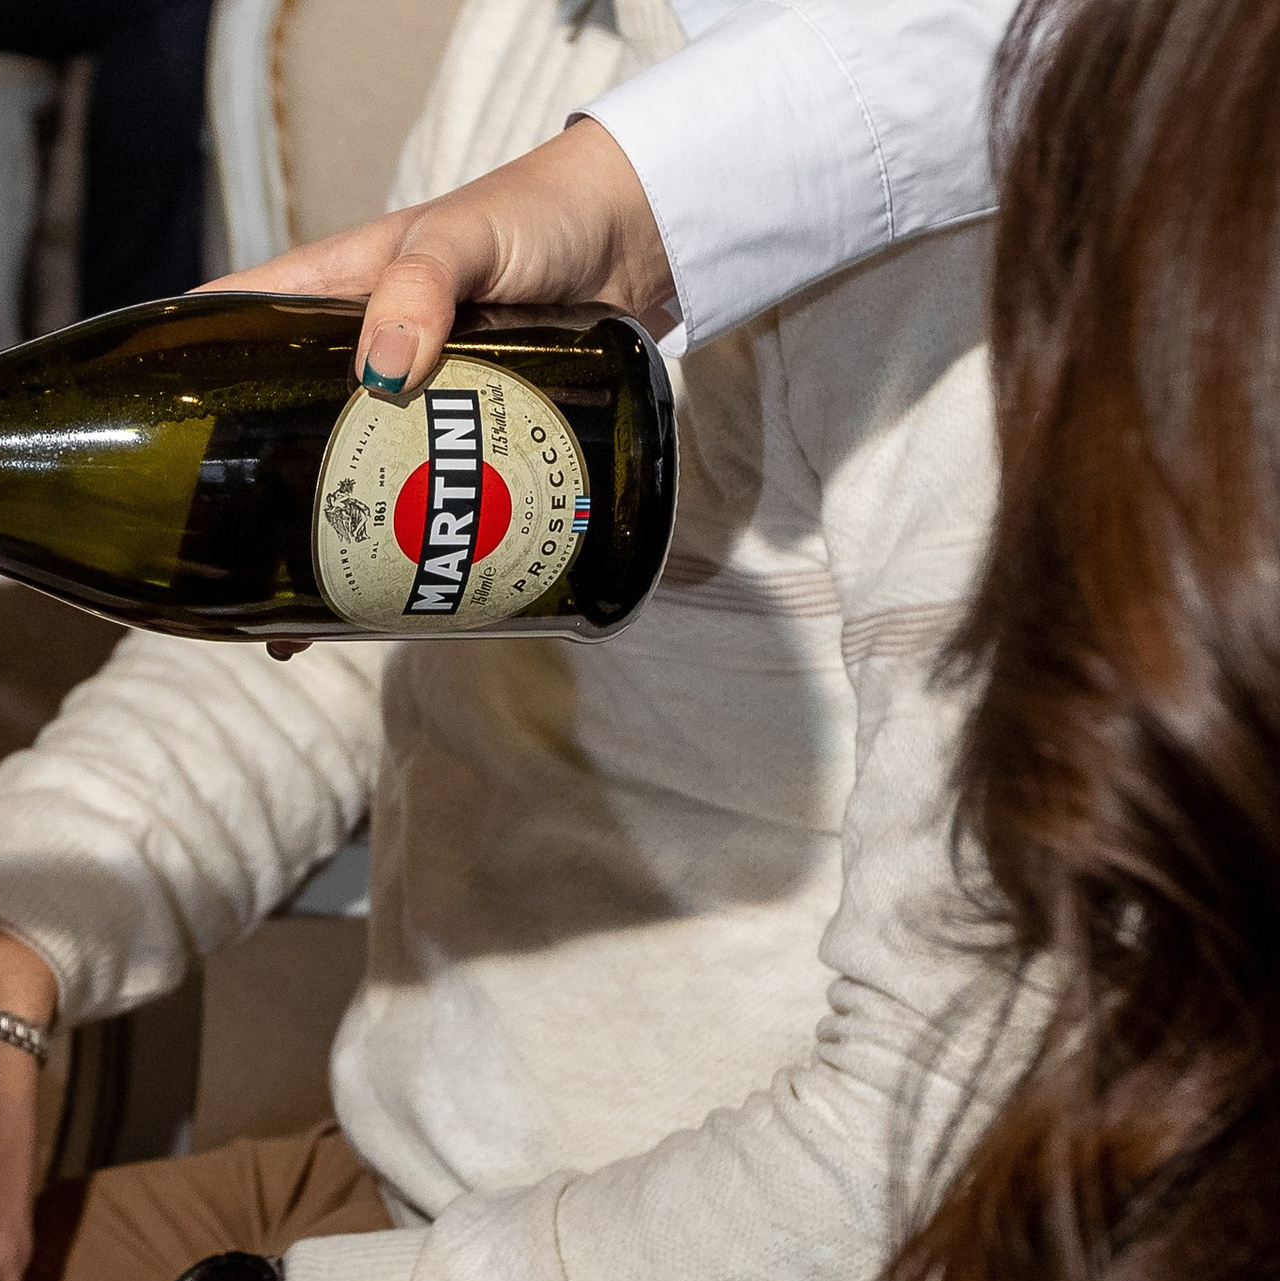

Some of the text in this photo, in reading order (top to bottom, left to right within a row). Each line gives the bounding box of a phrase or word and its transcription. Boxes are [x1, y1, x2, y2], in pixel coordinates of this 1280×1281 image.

[340, 422, 376, 593] TORINO ITALIA
[371, 541, 380, 559] DAL
[373, 501, 387, 527] 1863
[410, 398, 477, 610] MARTINI
[512, 426, 567, 593] PROSECCO
[521, 490, 534, 535] D.O.C.
[542, 434, 581, 586] PRODOTTO IN ITALIA
